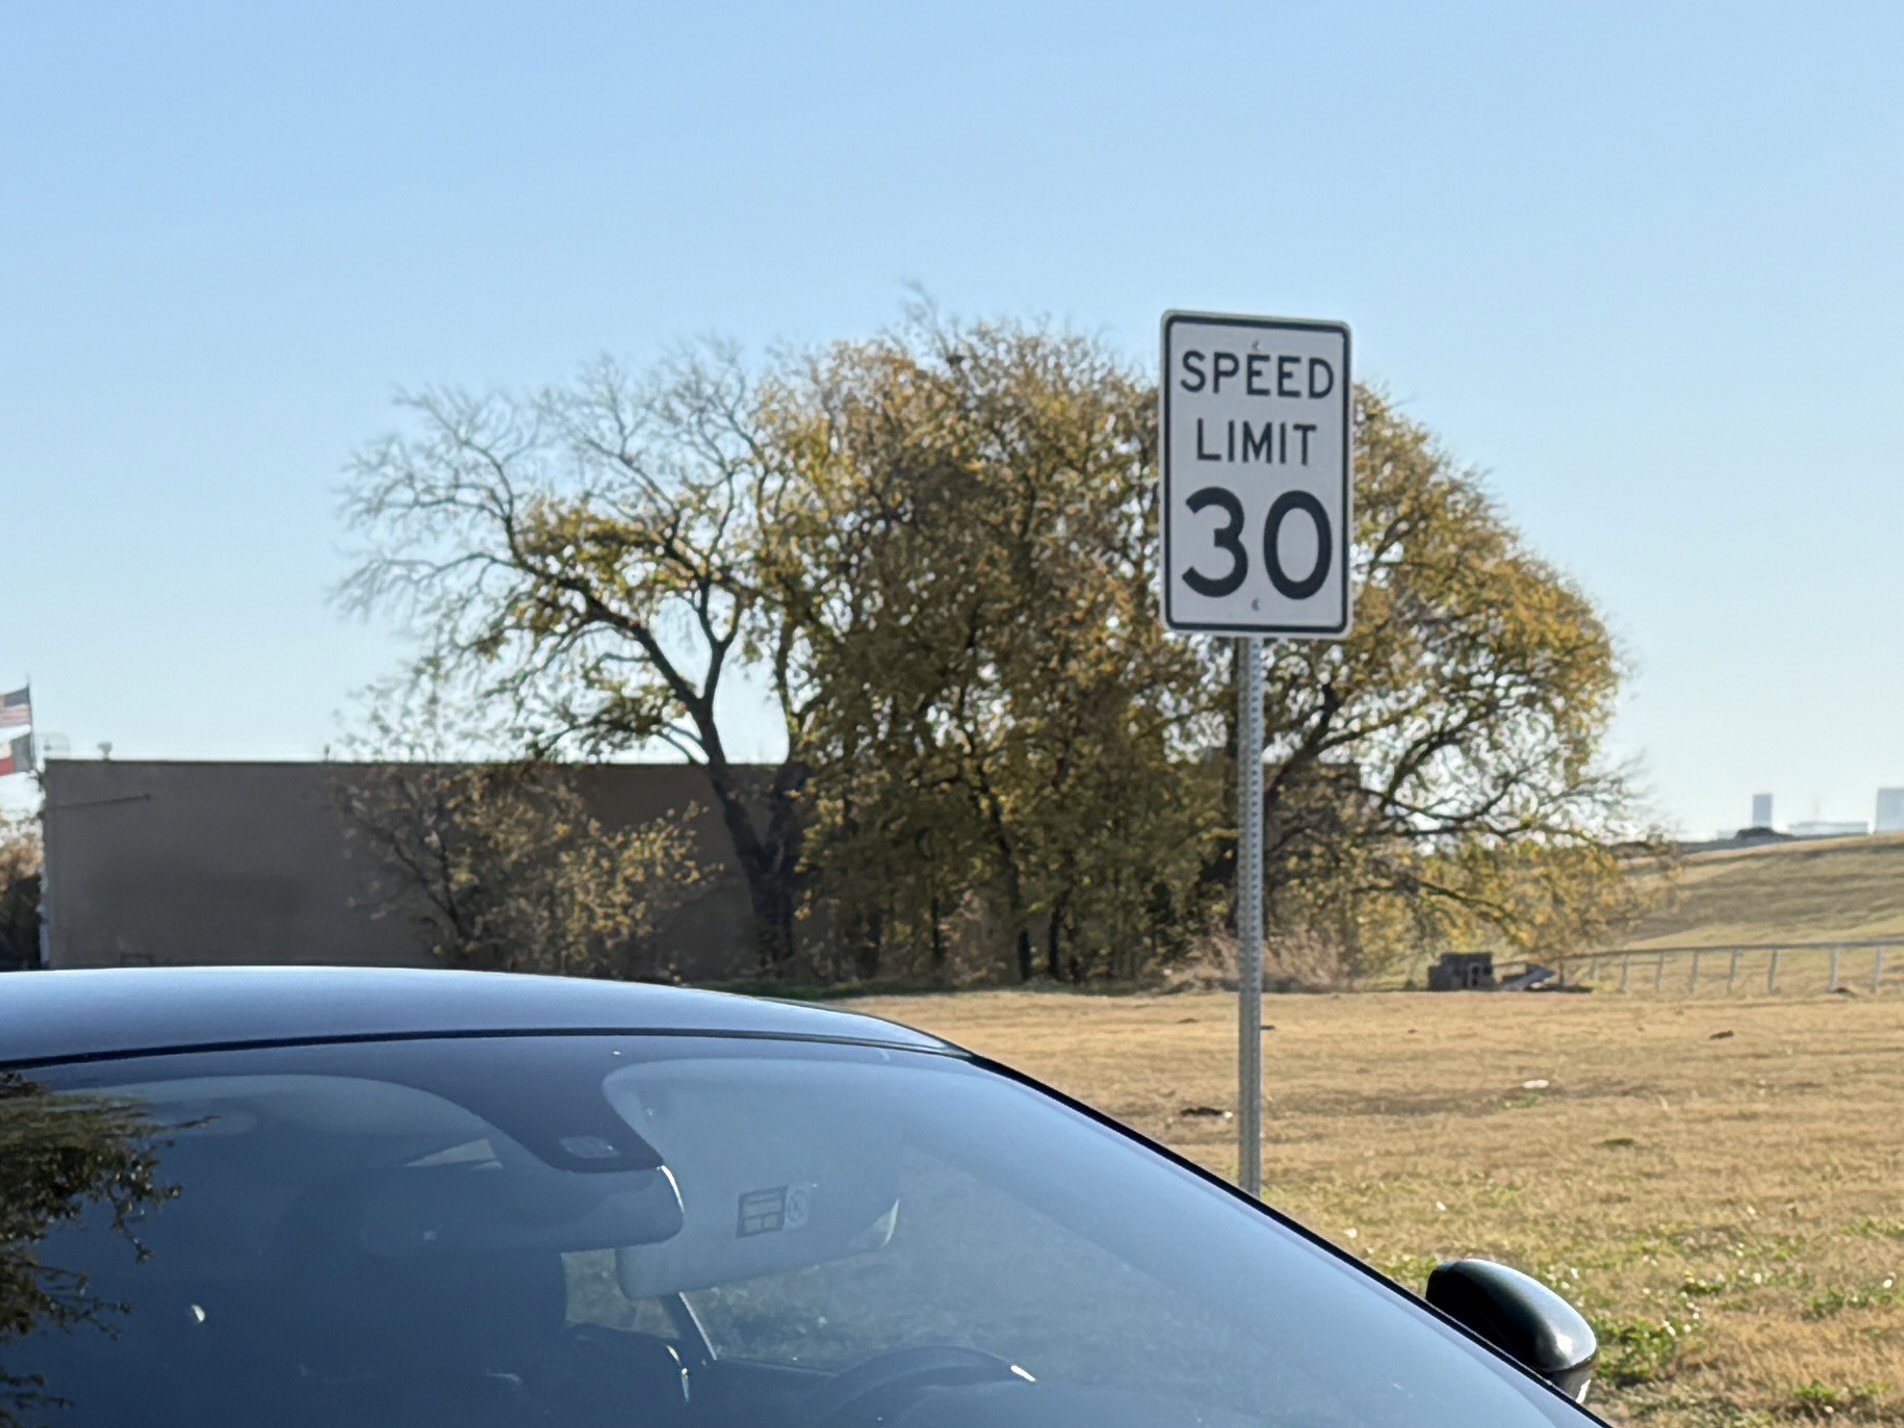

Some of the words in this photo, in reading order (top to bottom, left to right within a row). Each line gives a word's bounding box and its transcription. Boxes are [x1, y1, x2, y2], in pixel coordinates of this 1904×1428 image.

[1180, 349, 1335, 400] SPEED
[1196, 417, 1318, 466] LIMIT
[1181, 486, 1333, 600] 30
